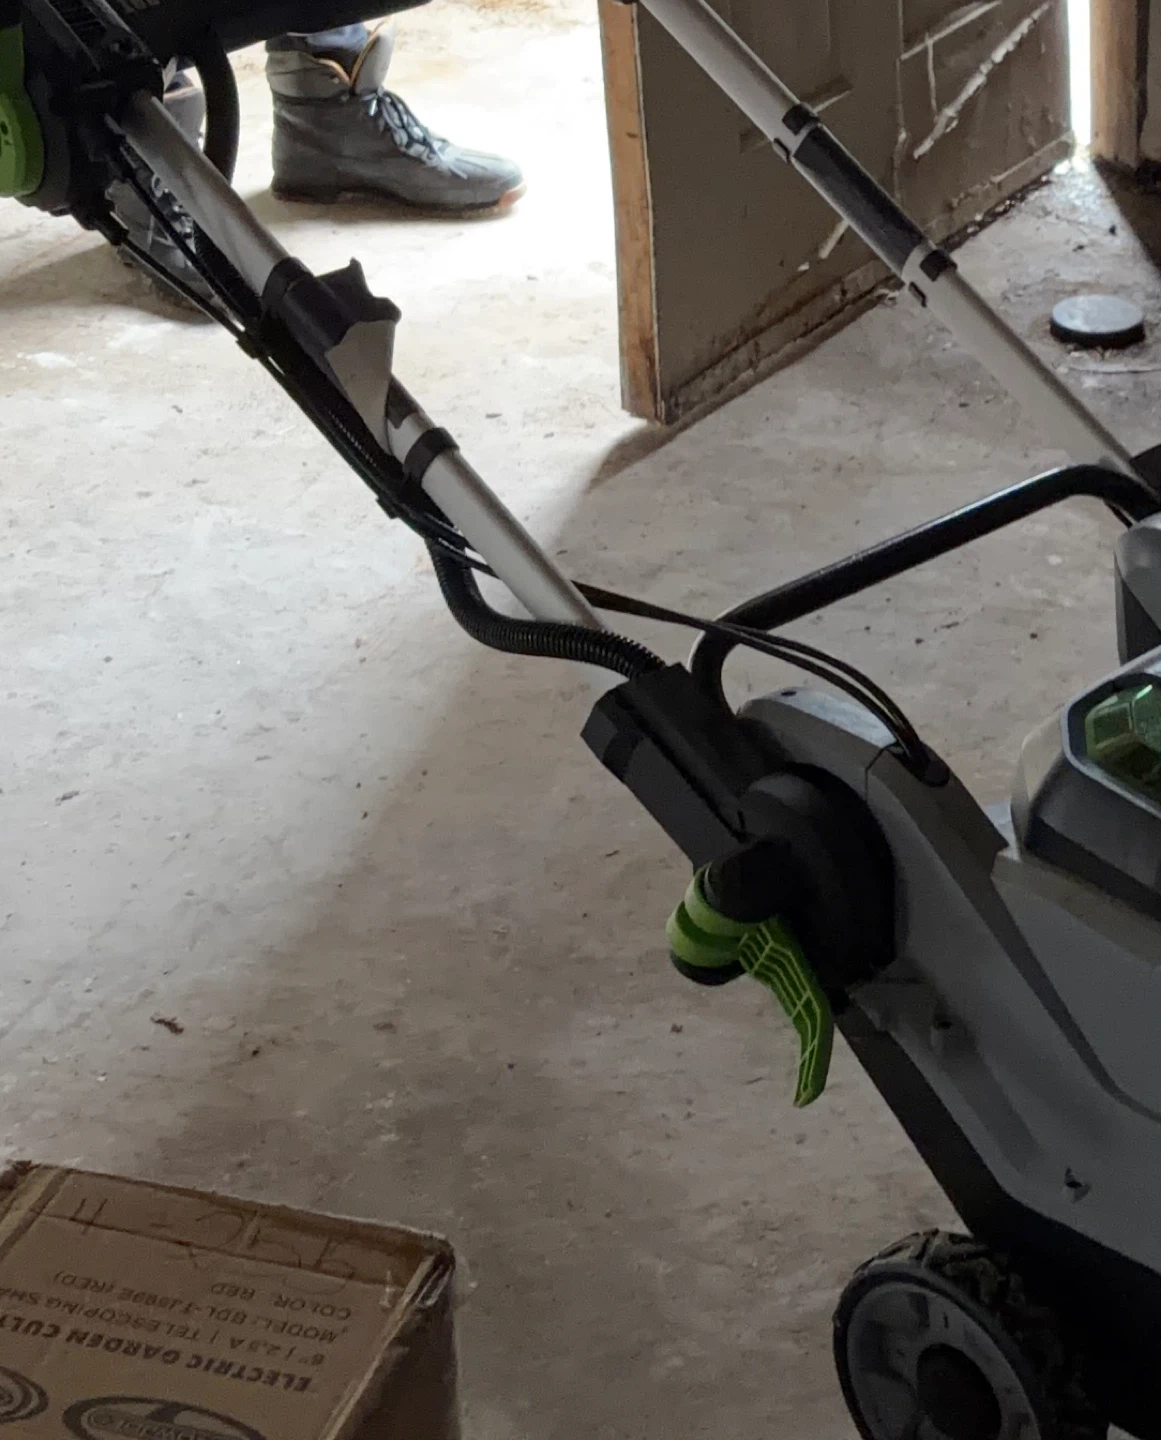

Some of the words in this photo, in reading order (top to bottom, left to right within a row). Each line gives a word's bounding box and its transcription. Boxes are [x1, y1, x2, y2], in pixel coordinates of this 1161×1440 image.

[210, 1282, 256, 1300] RED
[45, 1297, 200, 1340] TELESCOPING
[65, 1329, 181, 1365] GARDEN
[185, 1353, 313, 1392] ELECTRIC
